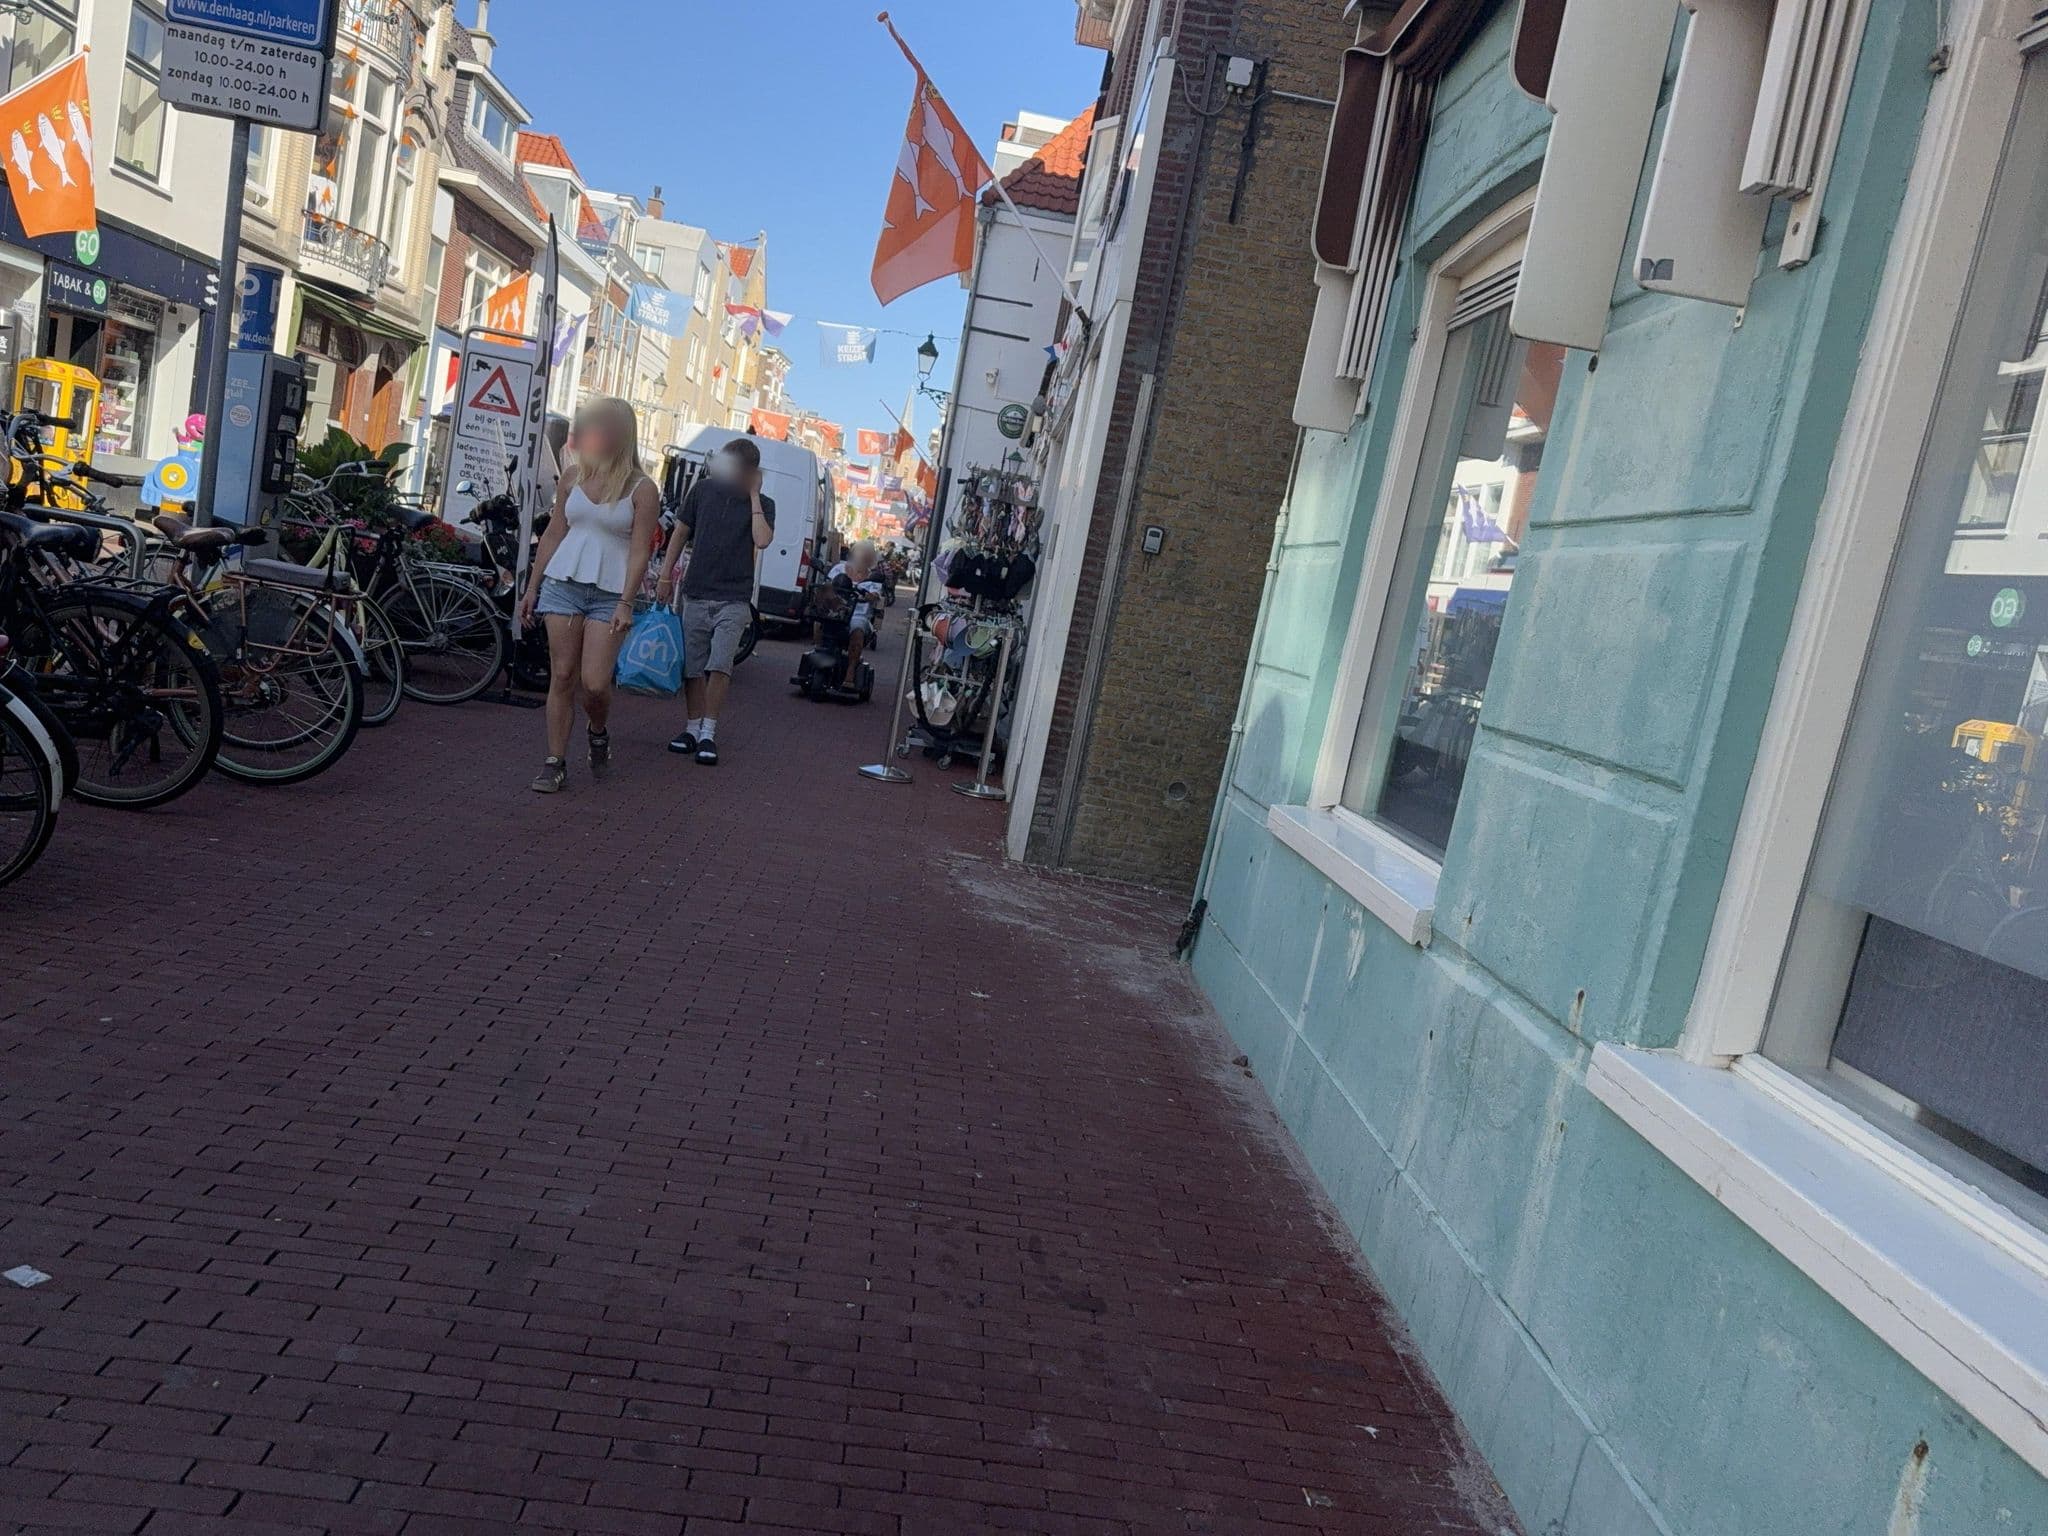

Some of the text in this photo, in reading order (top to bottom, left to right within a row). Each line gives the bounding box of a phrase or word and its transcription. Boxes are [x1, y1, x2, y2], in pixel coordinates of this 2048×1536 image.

[177, 0, 315, 35] www.denhaag.nl/parkeren
[168, 27, 317, 68] maandag t/m zaterdag
[195, 51, 286, 79] 10.00-24.00 h
[168, 68, 309, 103] zondag 10.00-24.00 h
[191, 92, 281, 118] max. 180 min.
[79, 230, 98, 256] GO
[53, 271, 106, 299] TABAK & GO
[475, 414, 485, 424] bij
[456, 442, 478, 453] laden
